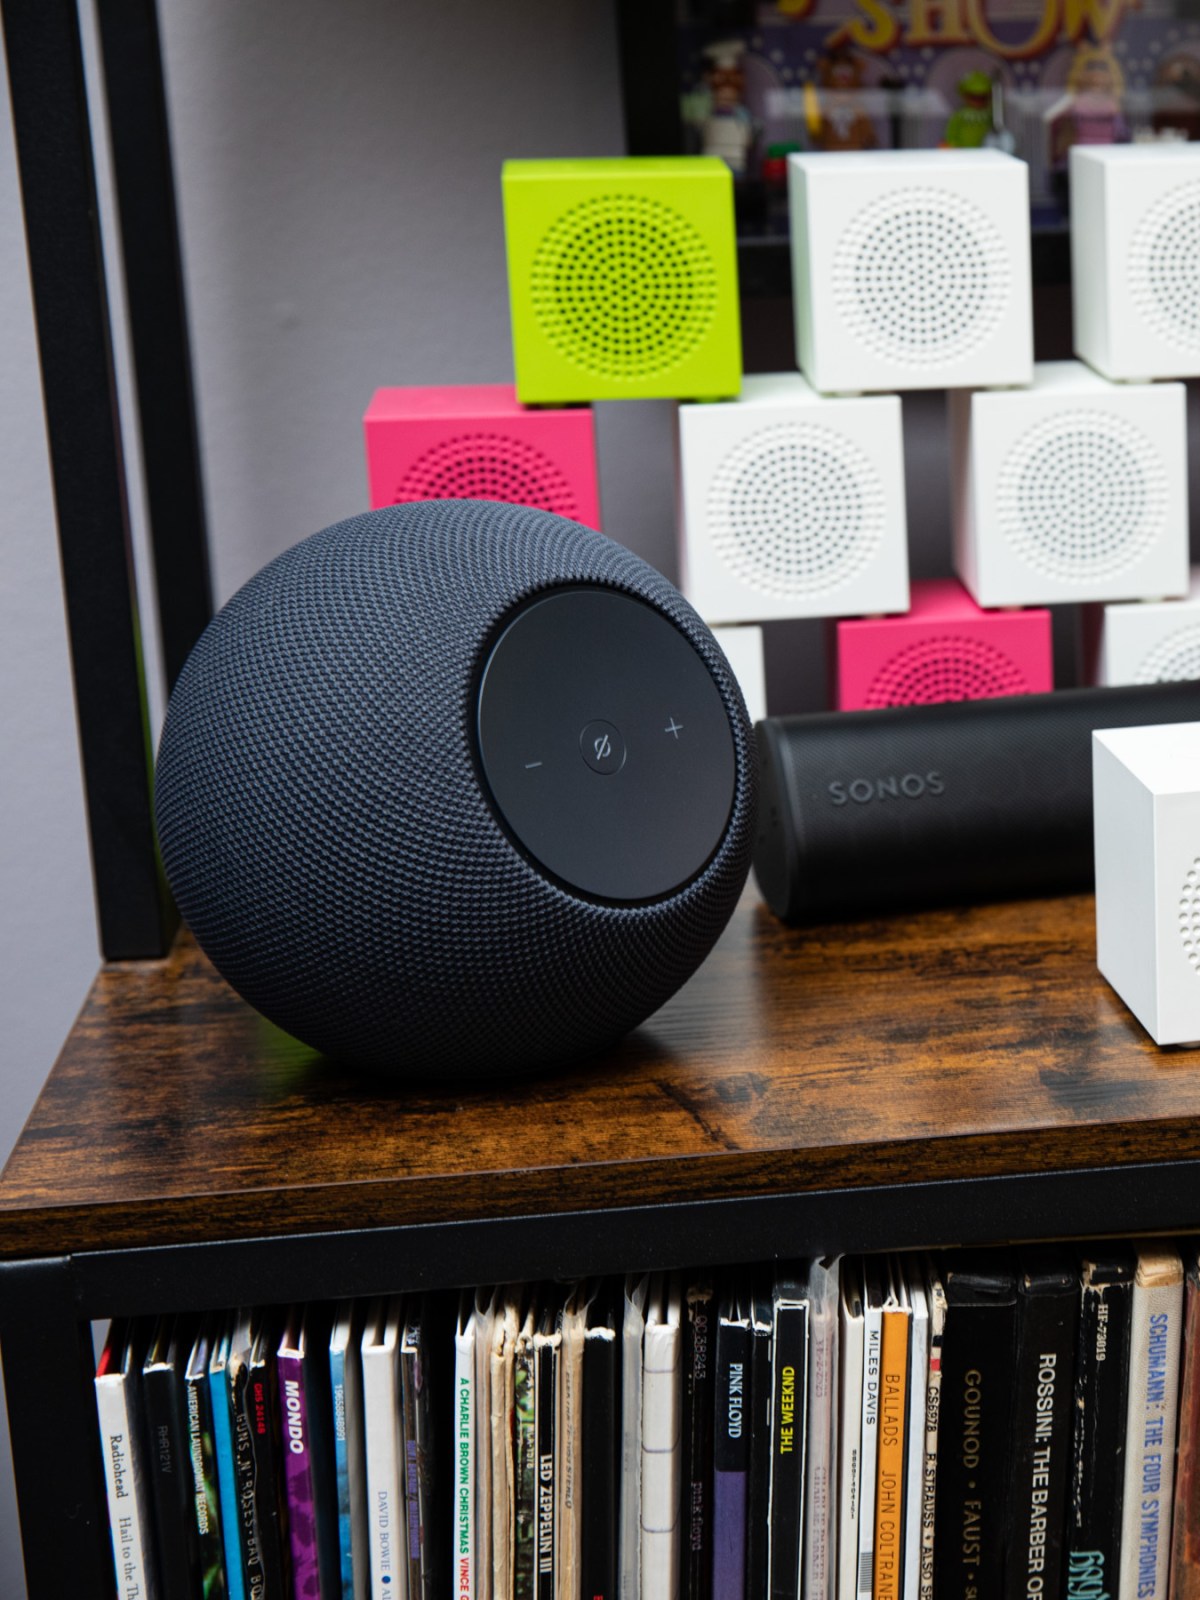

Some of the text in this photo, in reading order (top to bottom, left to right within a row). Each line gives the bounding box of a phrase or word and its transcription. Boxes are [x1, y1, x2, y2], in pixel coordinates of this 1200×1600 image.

[829, 770, 947, 807] SONOS
[1095, 1303, 1110, 1362] HF-73019
[461, 1377, 470, 1386] A
[728, 1363, 743, 1438] PINK FLOYD
[866, 1330, 880, 1426] MILES DAVIS
[1035, 1353, 1057, 1444] ROSSINI:
[284, 1380, 305, 1455] MONDO
[460, 1388, 470, 1439] CHARLIE
[780, 1365, 796, 1455] THE WEEKND
[884, 1374, 902, 1447] BALLADS
[926, 1386, 940, 1433] CS6978
[964, 1369, 982, 1469] GOUNOD
[109, 1434, 129, 1499] Radiohead
[187, 1385, 210, 1535] AMERICAN LAUNDROMAT RECORDS
[460, 1441, 470, 1485] BROWN
[1032, 1445, 1051, 1487] THE
[1137, 1313, 1168, 1600] SCHUMANN: THE FOUR SYMPHONIES
[378, 1491, 390, 1529] DAVID
[460, 1487, 470, 1555] CHRISTMAS
[540, 1454, 553, 1574] LED ZEPPELIN III
[881, 1470, 896, 1514] JOHN
[923, 1470, 938, 1529] STRAUSS
[118, 1516, 132, 1544] Hail
[122, 1546, 131, 1559] to
[380, 1532, 391, 1572] BOWIE
[963, 1500, 982, 1566] FAUST
[1028, 1489, 1050, 1574] BARBER
[124, 1561, 136, 1581] the
[460, 1557, 470, 1592] VINCE
[921, 1545, 935, 1580] ALSO
